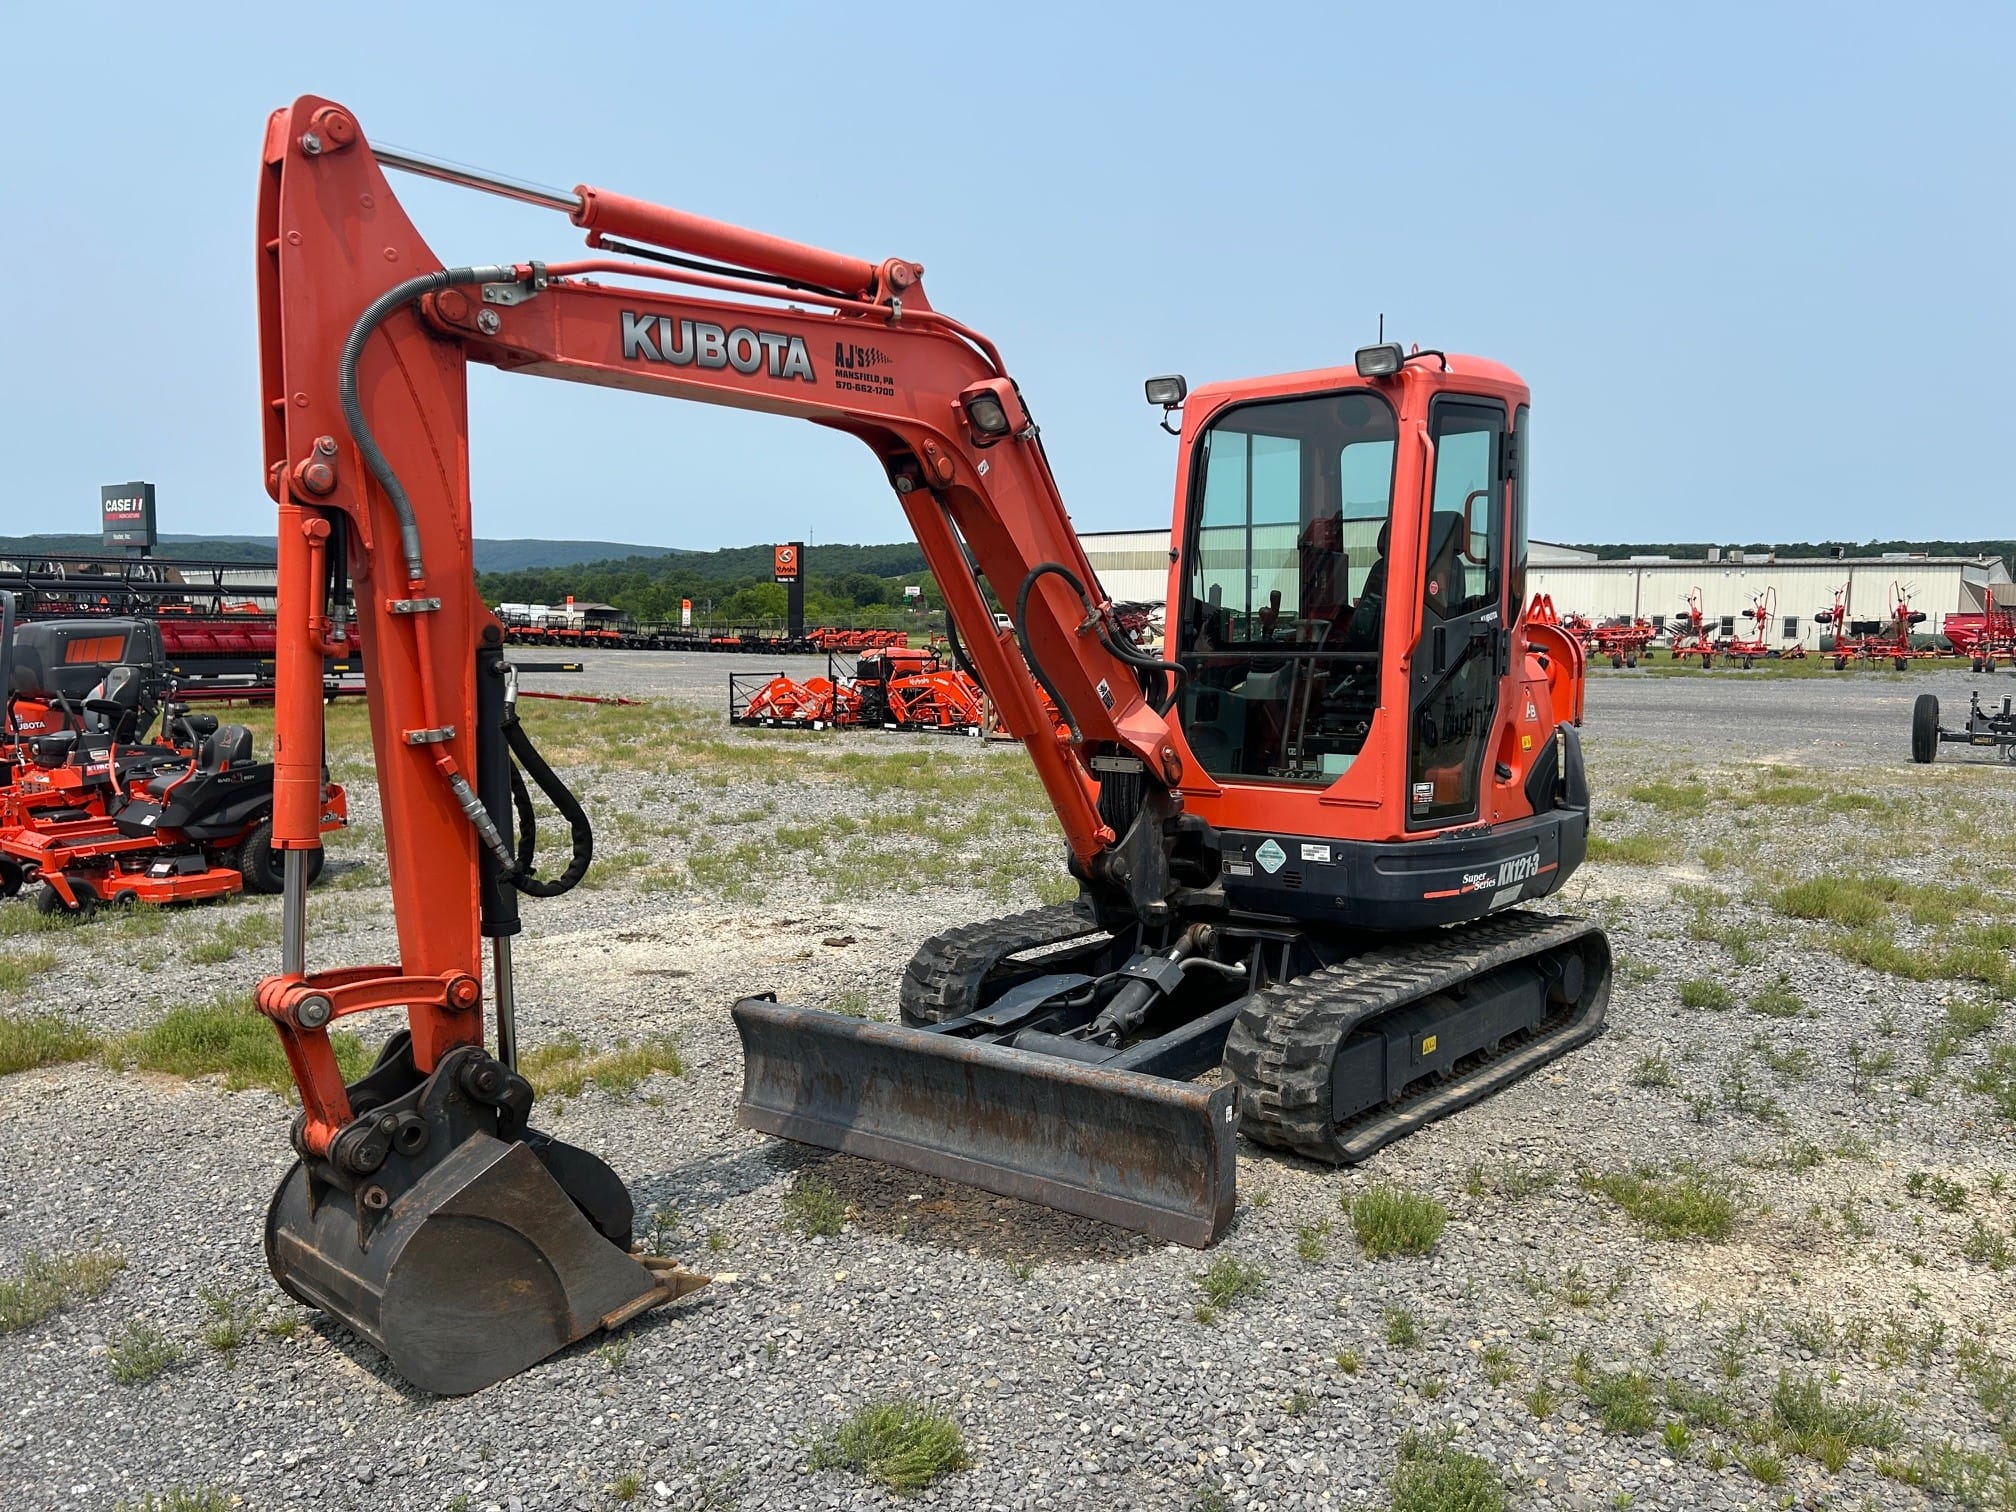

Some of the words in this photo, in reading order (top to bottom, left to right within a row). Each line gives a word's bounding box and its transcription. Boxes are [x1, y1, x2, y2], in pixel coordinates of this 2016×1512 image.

[621, 311, 816, 383] KUBOTA
[835, 342, 865, 369] AJ'S
[835, 369, 882, 385] MANSFIELD,
[883, 376, 894, 385] PA
[835, 381, 895, 396] 570-662-1700
[105, 499, 131, 512] CASE
[86, 762, 120, 772] KUBOA
[1497, 853, 1540, 887] KX121-3
[1462, 872, 1487, 885] Super
[1473, 878, 1496, 891] Series
